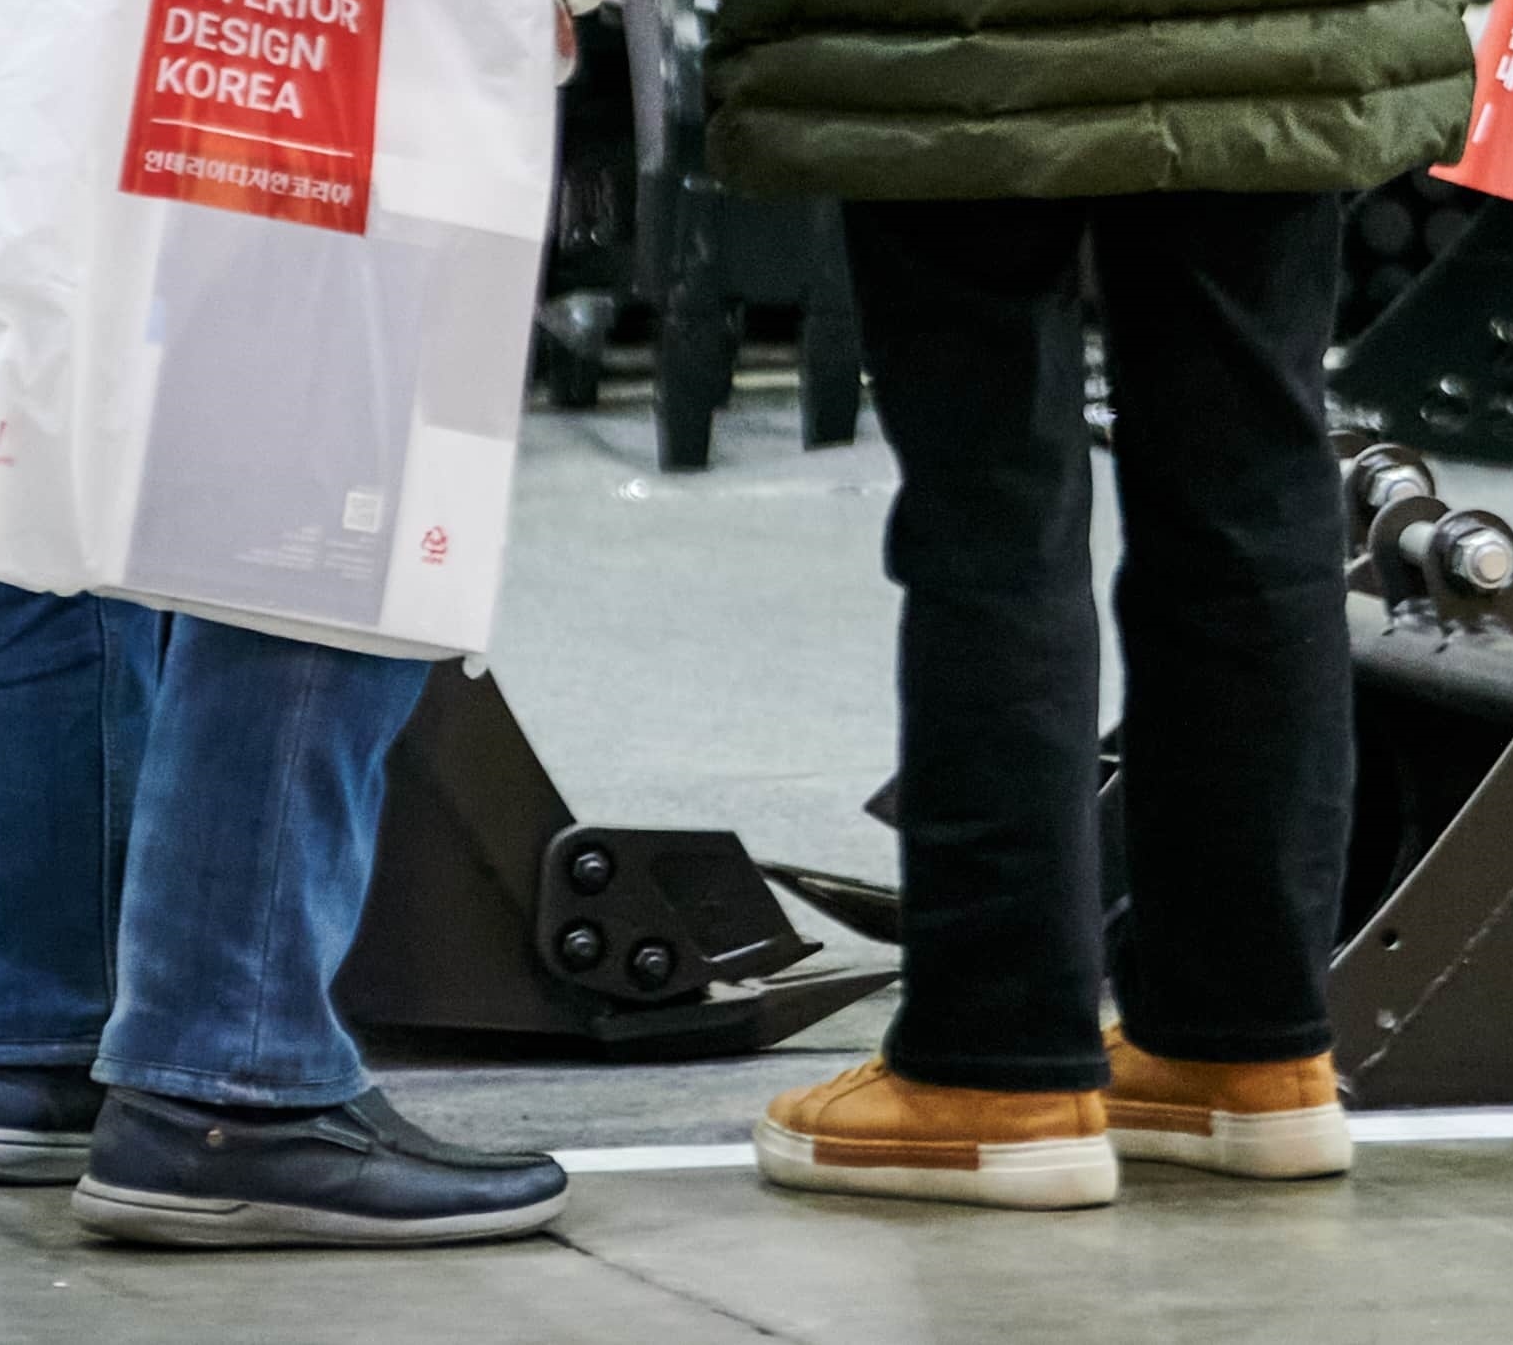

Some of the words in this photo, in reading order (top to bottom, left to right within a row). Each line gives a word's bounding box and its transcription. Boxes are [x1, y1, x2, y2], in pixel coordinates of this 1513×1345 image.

[163, 8, 327, 73] DESIGN
[155, 57, 303, 120] KOREA
[143, 149, 352, 208] 인테리어디자인코리아
